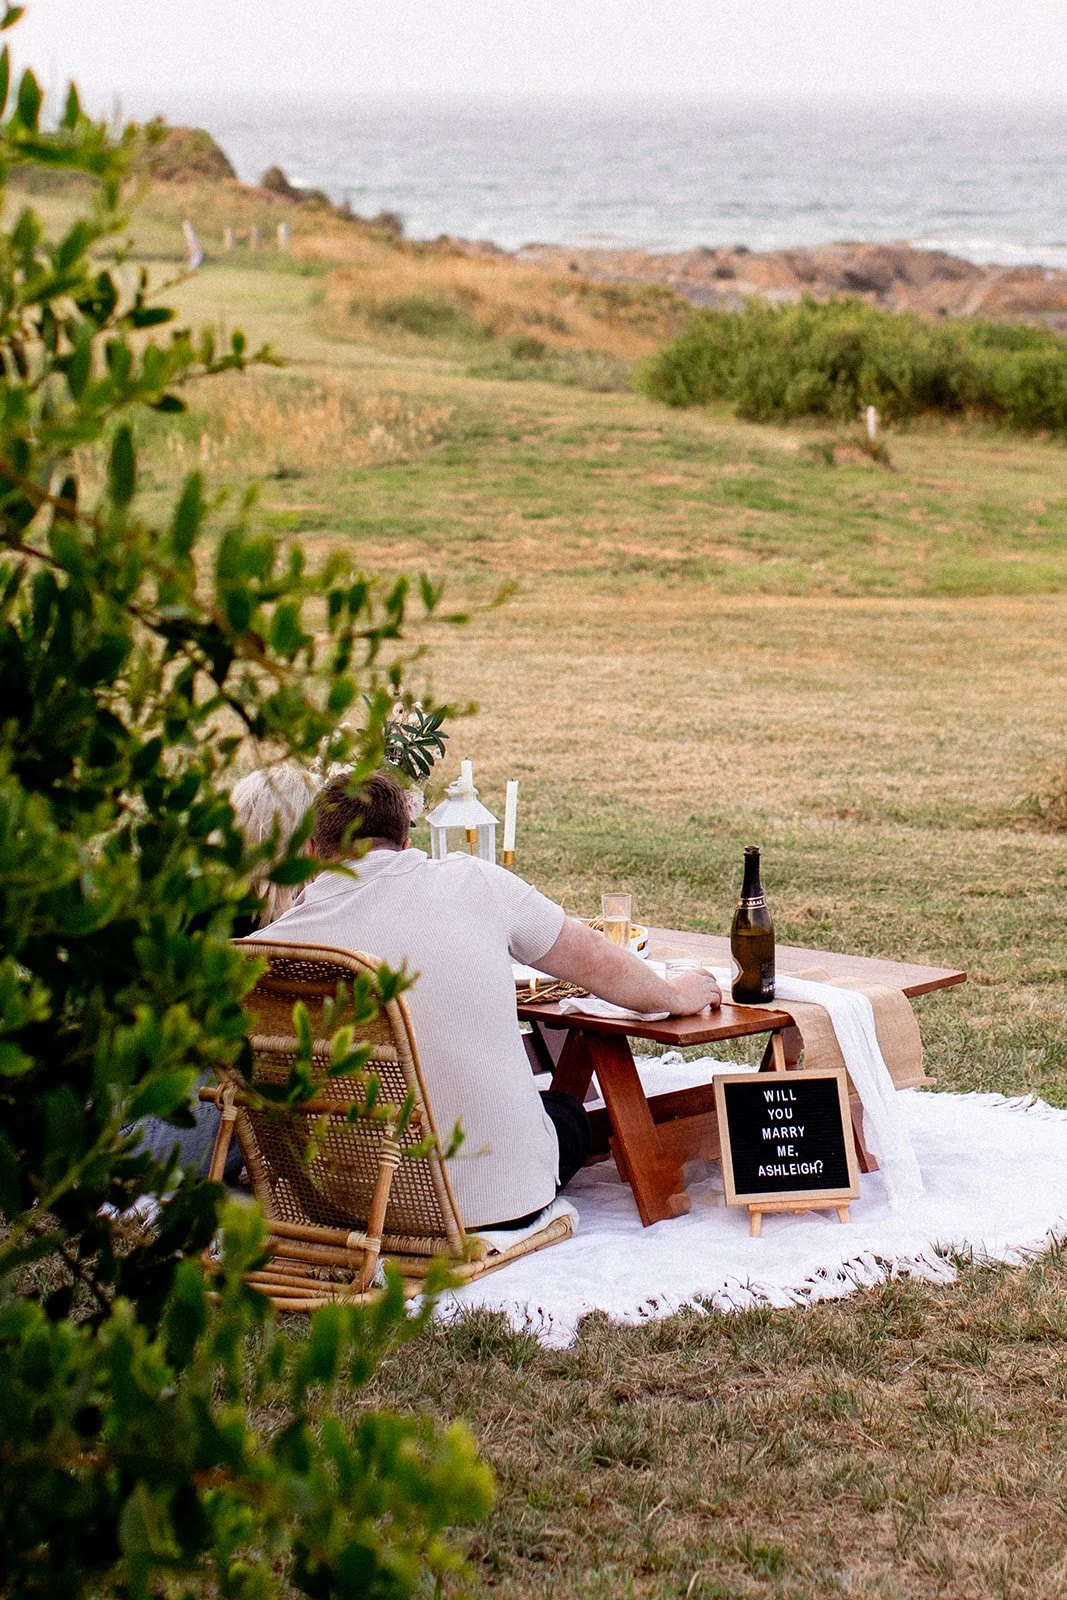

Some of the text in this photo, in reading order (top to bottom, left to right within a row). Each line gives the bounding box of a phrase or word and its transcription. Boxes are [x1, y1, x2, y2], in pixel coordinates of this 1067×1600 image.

[763, 1089, 797, 1103] WILL
[767, 1107, 793, 1120] YOU
[762, 1126, 805, 1140] MARRY
[758, 1160, 824, 1176] ASHLEIGH?
